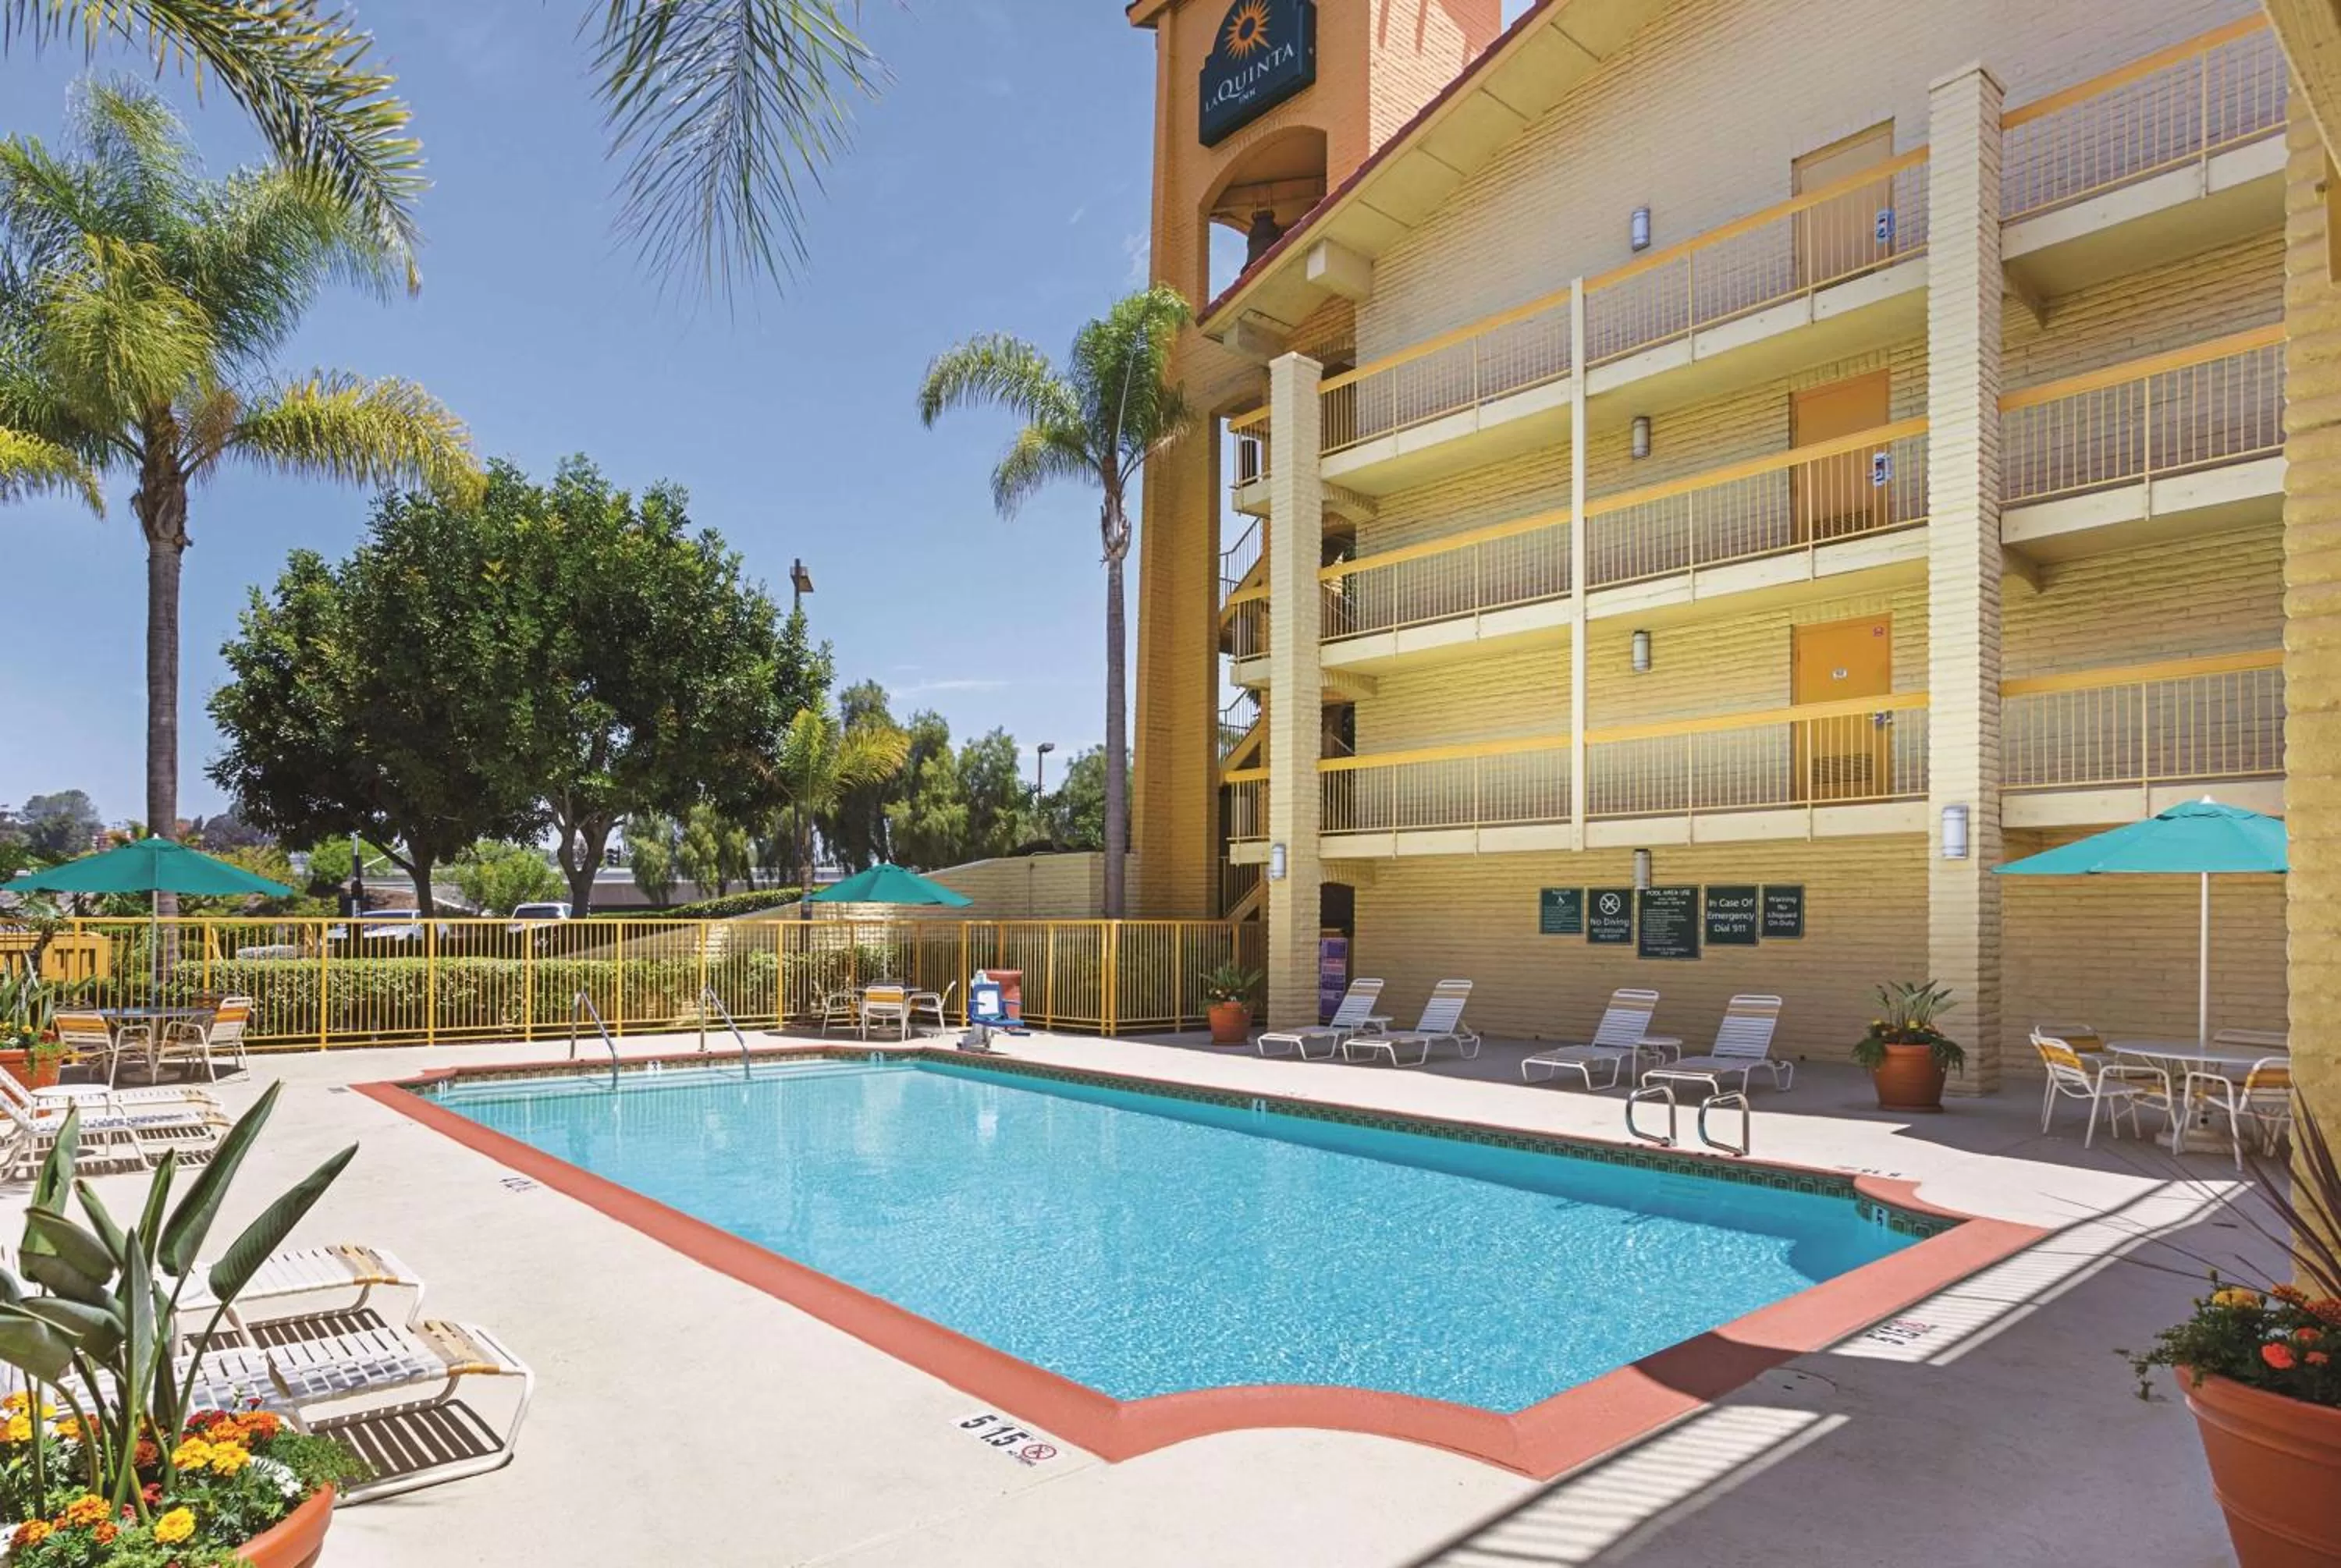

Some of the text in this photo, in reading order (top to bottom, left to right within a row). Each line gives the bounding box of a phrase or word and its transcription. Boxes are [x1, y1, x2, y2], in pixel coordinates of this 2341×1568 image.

[1218, 43, 1295, 101] QUINTA
[1708, 898, 1753, 907] In Case Of
[1707, 911, 1755, 921] Emergency
[1604, 917, 1630, 928] Diving
[1714, 924, 1746, 932] Dial 911
[960, 1414, 999, 1429] 5
